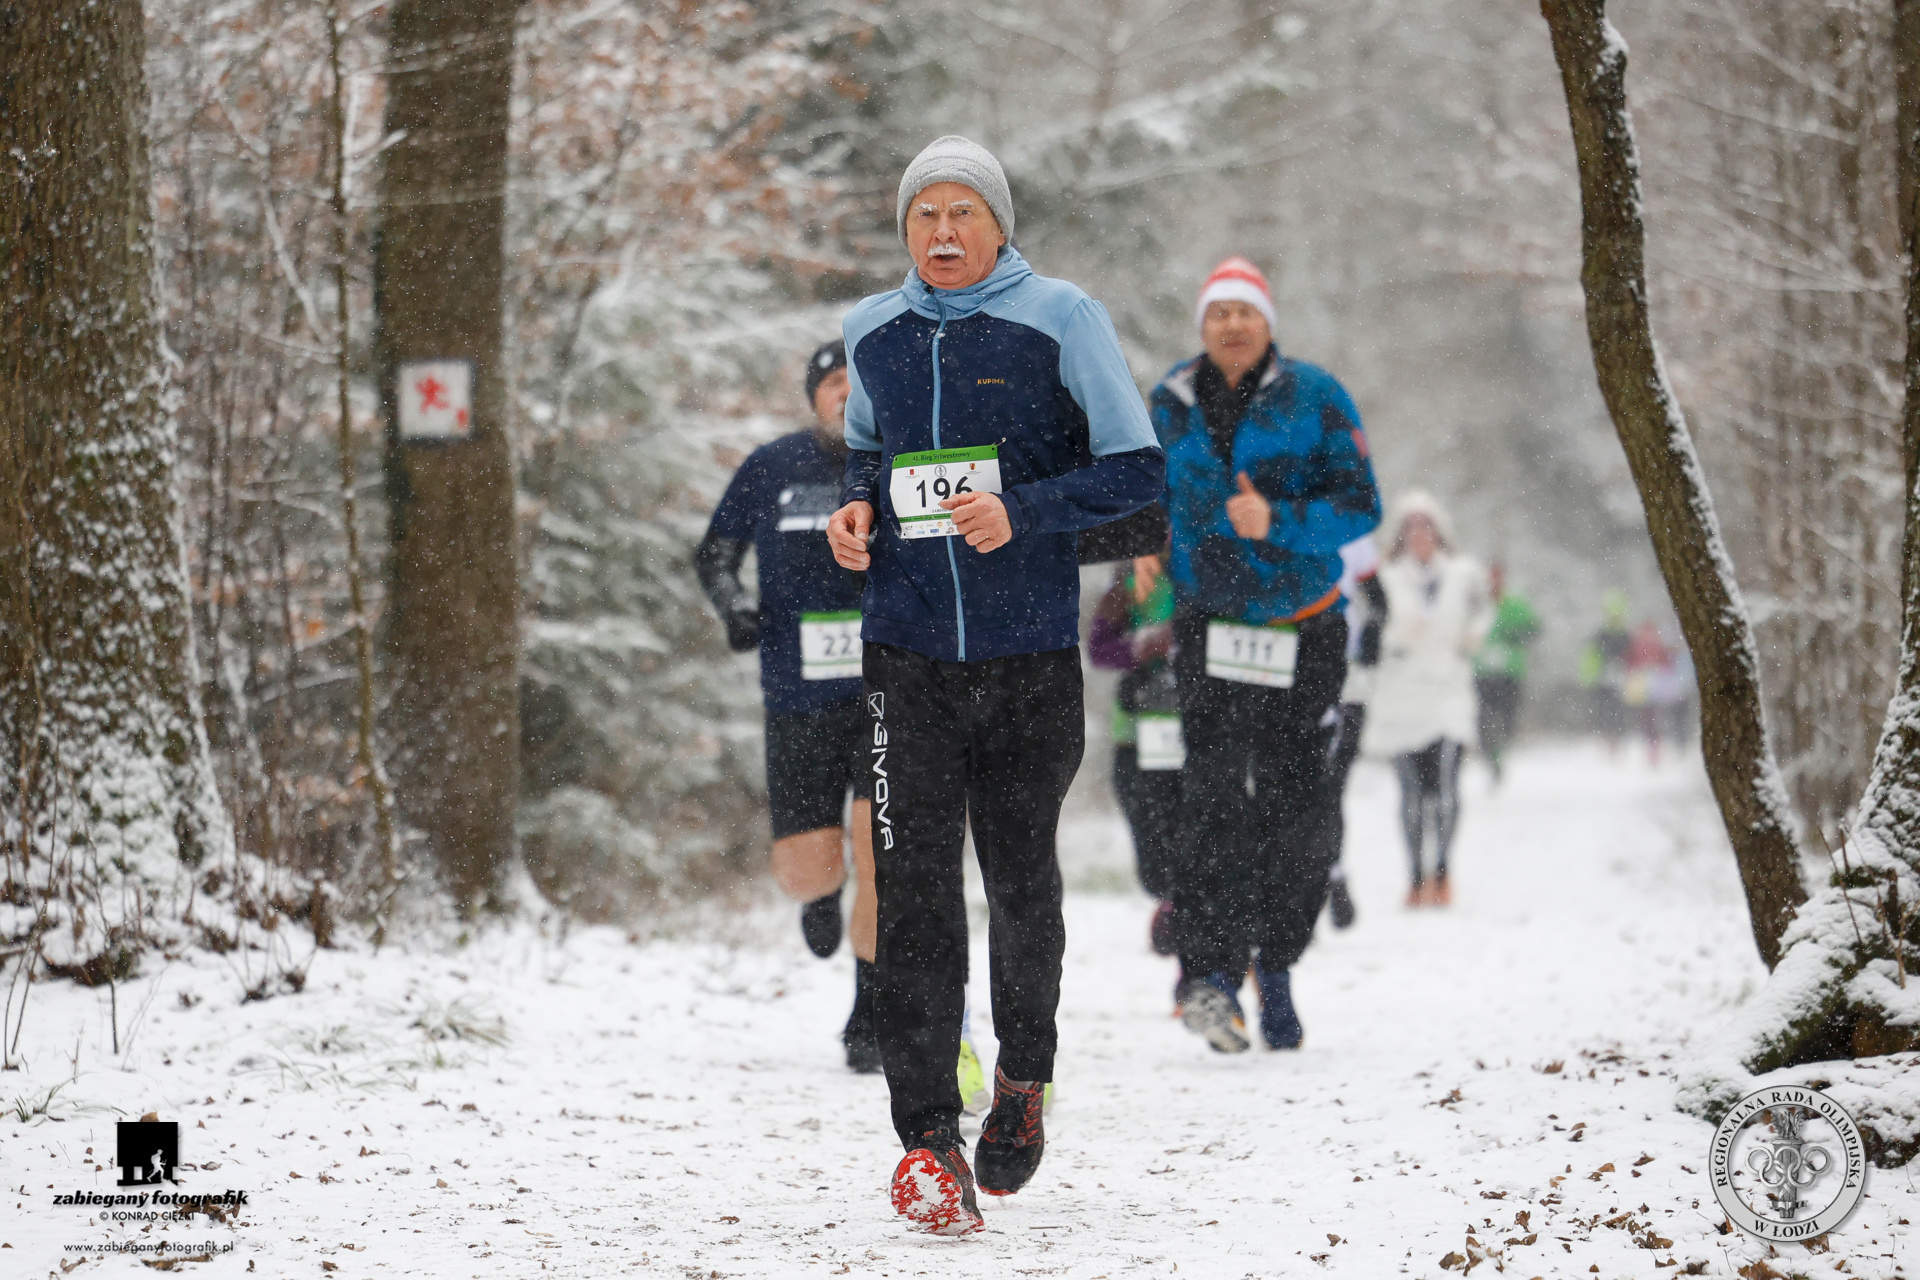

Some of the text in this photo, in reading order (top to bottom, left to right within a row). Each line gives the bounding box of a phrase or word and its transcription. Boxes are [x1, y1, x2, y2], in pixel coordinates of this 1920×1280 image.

[822, 632, 863, 657] 22
[1233, 638, 1273, 664] 111
[871, 722, 894, 850] GIVOVA
